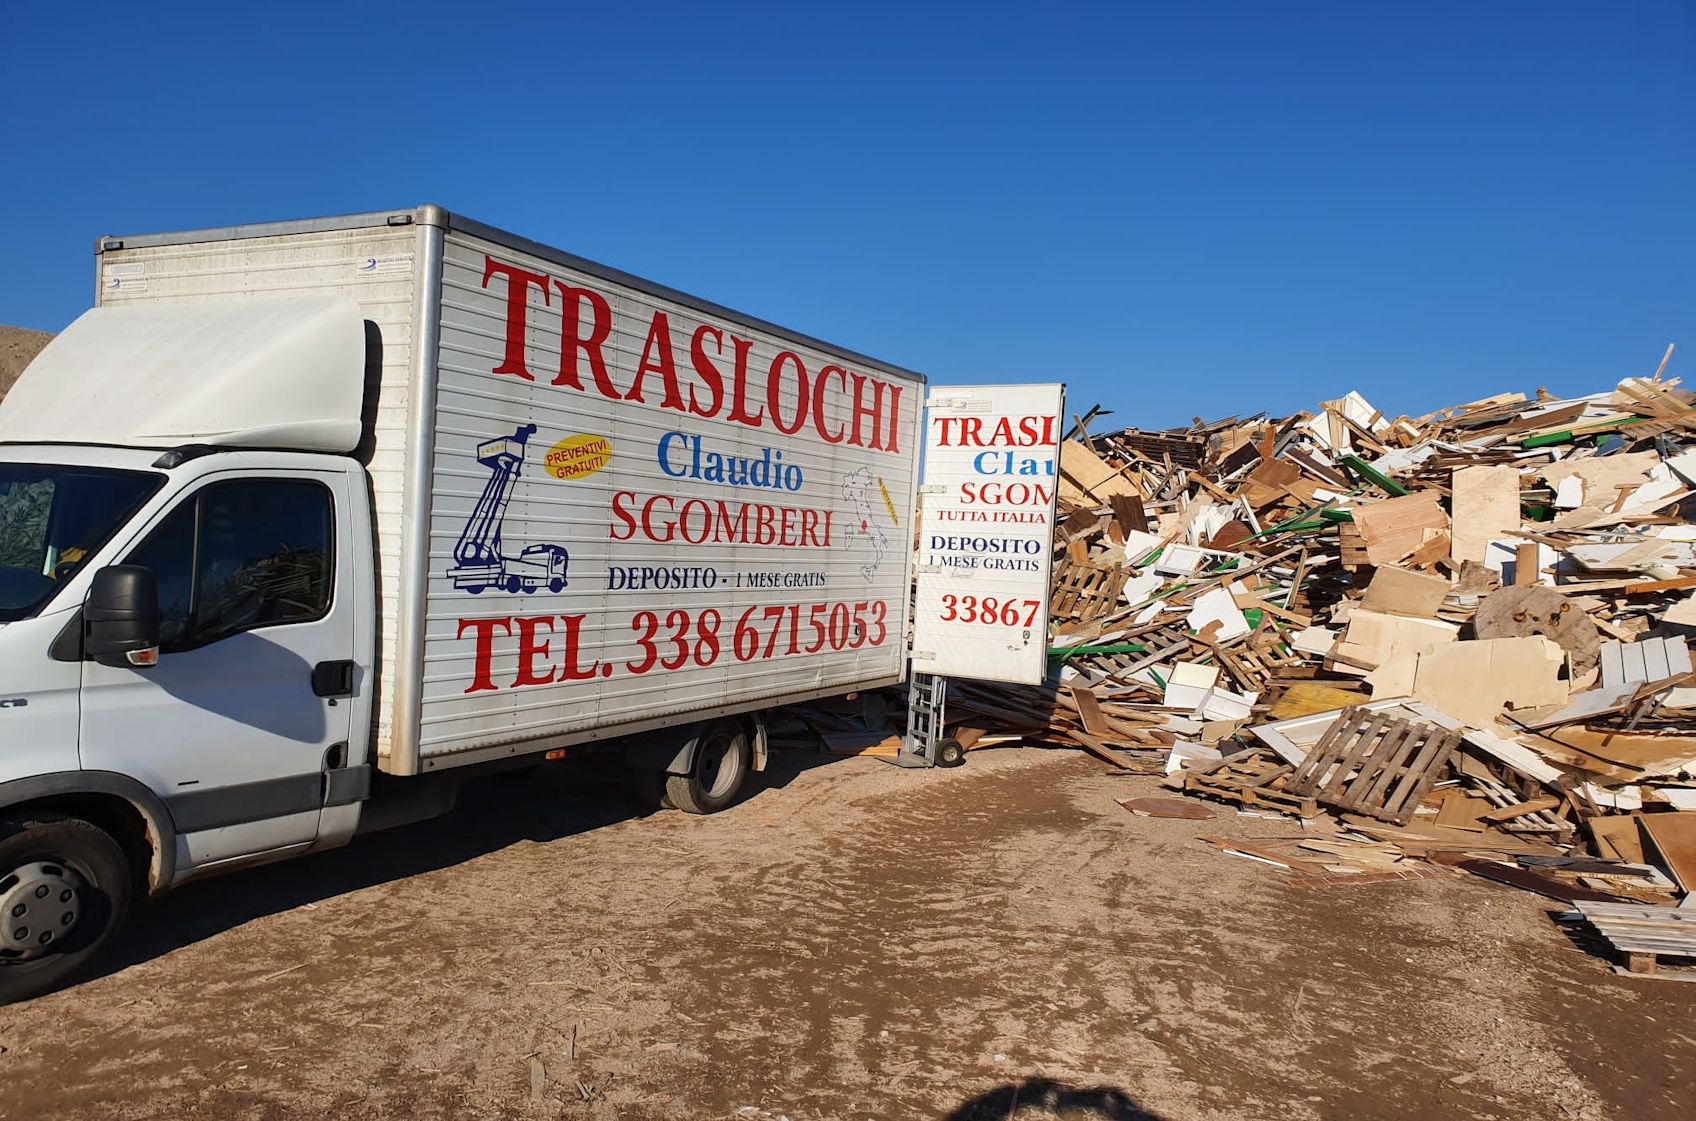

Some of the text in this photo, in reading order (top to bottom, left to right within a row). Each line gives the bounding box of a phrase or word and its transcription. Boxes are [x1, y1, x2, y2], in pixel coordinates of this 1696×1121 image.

[482, 256, 903, 453] TRASLOCHI
[933, 416, 1057, 447] TRASL
[547, 440, 607, 465] PREVENTIVI
[657, 431, 803, 491] Claudio
[556, 456, 604, 479] GRATUITI
[609, 491, 833, 547] SGOMBERI
[937, 511, 1046, 524] TUTTA ITALIA
[931, 536, 1041, 554] DEPOSITO
[940, 556, 979, 569] MESE
[983, 558, 1040, 572] GRATIS
[607, 567, 717, 590] DEPOSITO
[746, 572, 781, 588] MESE
[784, 571, 826, 588] GRATIS
[940, 594, 1041, 628] 33867
[456, 600, 887, 693] TEL. 338 6715053
